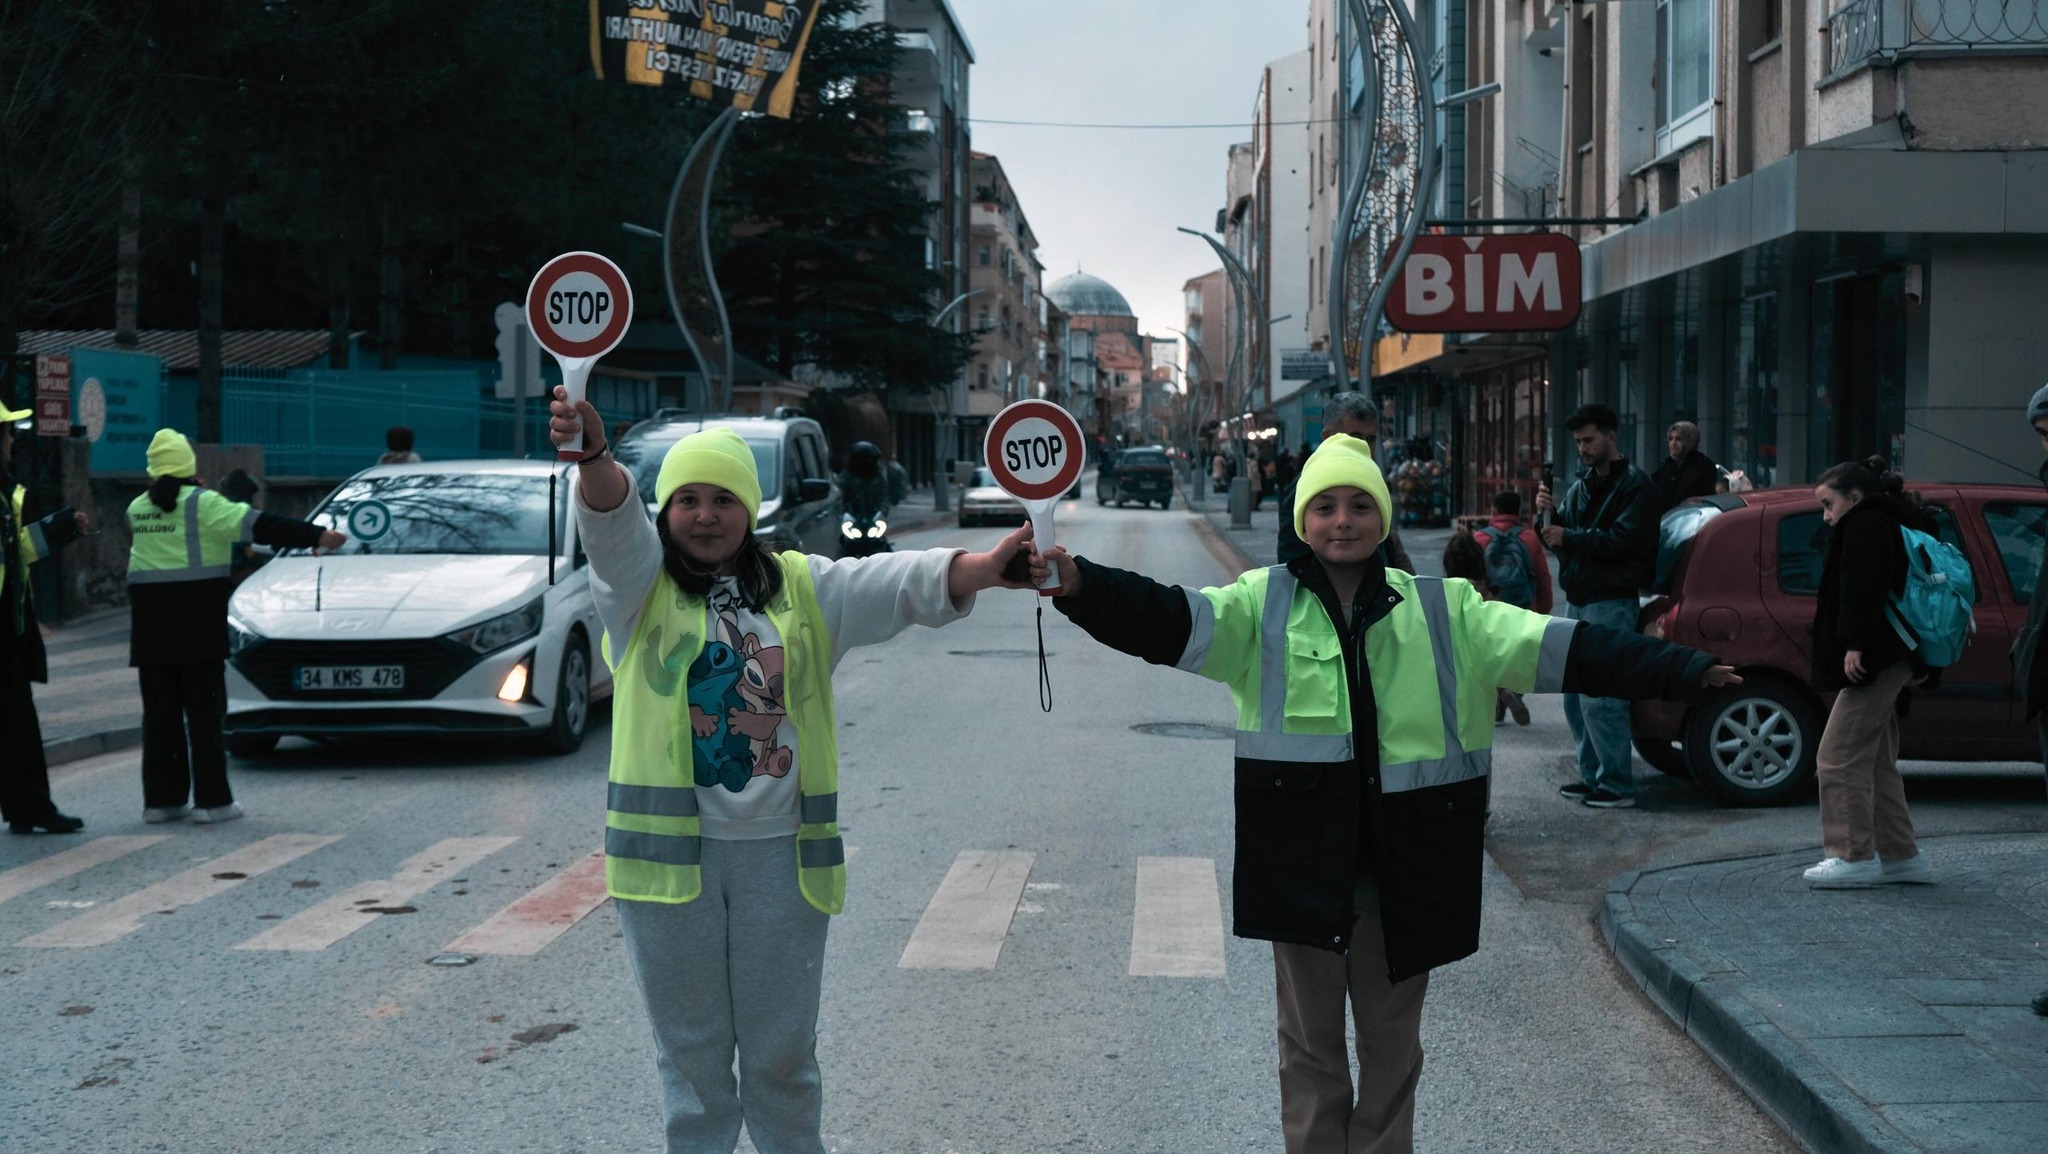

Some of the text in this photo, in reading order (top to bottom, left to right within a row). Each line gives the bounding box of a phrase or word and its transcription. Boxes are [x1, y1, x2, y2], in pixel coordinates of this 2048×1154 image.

[1404, 237, 1563, 316] BİM
[549, 291, 610, 325] STOP
[1006, 435, 1062, 472] STOP
[303, 667, 401, 687] 34 KMS 478
